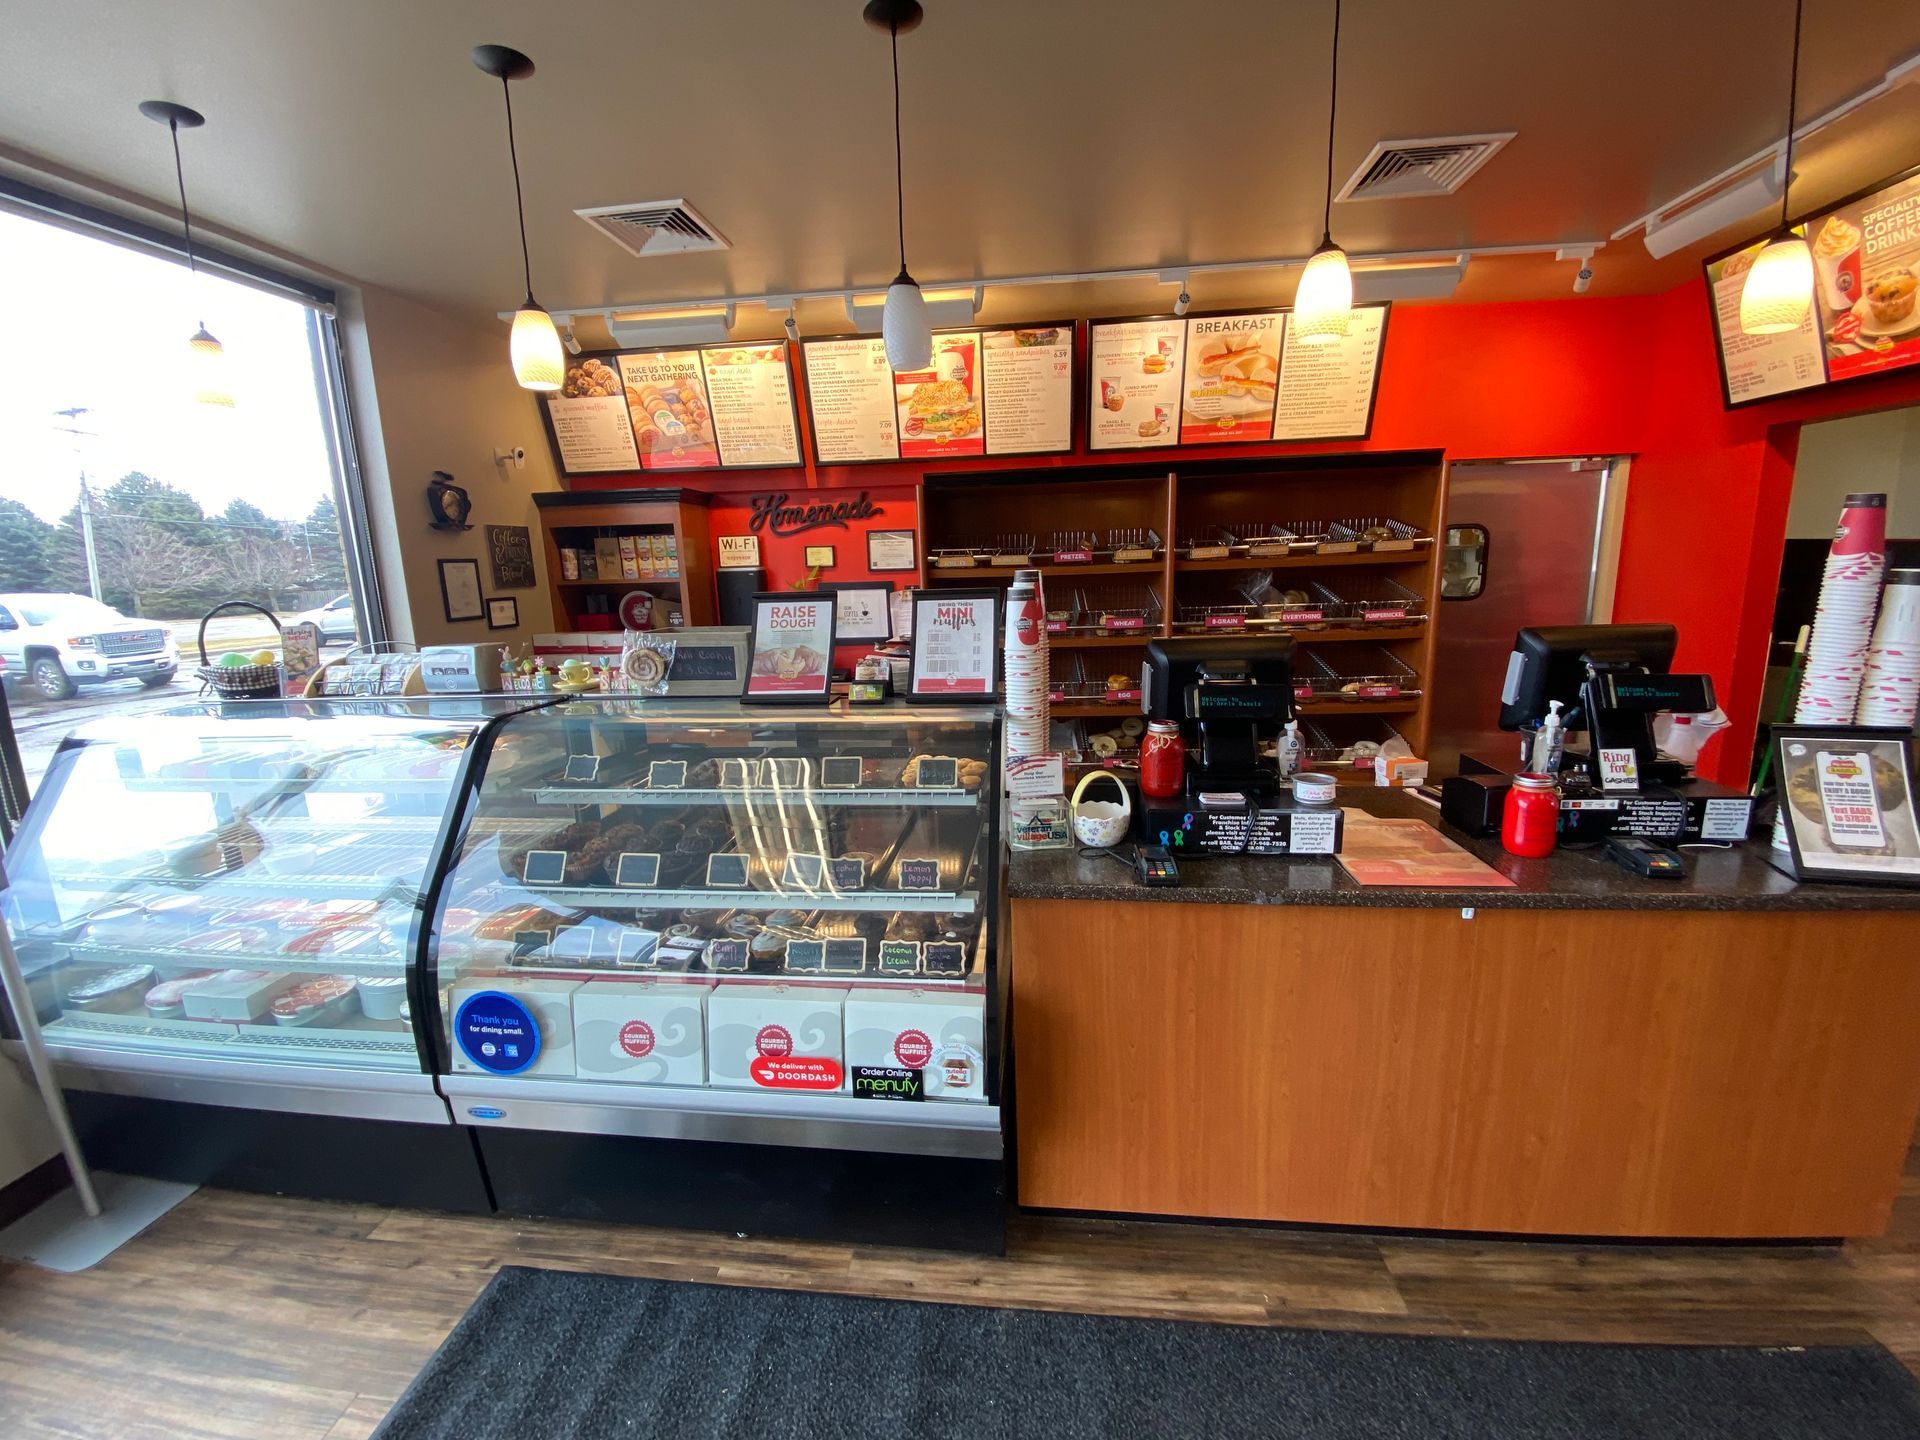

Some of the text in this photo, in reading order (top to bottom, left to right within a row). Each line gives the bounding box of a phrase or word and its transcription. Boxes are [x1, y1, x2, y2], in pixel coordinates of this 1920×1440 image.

[1196, 318, 1275, 333] BREAKFAST
[627, 363, 696, 375] TAKE US TO YOUR
[627, 371, 698, 383] NEXT GATHERING
[750, 491, 884, 536] Homemade
[721, 538, 756, 550] Wi-Fi
[771, 605, 816, 619] RAISE
[937, 607, 974, 619] MINI
[1365, 611, 1405, 620] PUMPERNICKEL
[770, 618, 816, 629] DOUGH
[1602, 752, 1631, 763] Ring
[1610, 763, 1627, 774] for
[1830, 806, 1848, 814] Text
[1016, 825, 1052, 833] veteran
[904, 864, 931, 873] Lemon
[884, 946, 913, 955] Coconut
[886, 957, 910, 965] Cream
[471, 1014, 519, 1027] Thank you
[481, 1026, 503, 1035] dining
[781, 1062, 807, 1070] deliver
[777, 1071, 836, 1082] DOORDASH
[860, 1068, 913, 1078] Order Online
[856, 1077, 919, 1096] menufy
